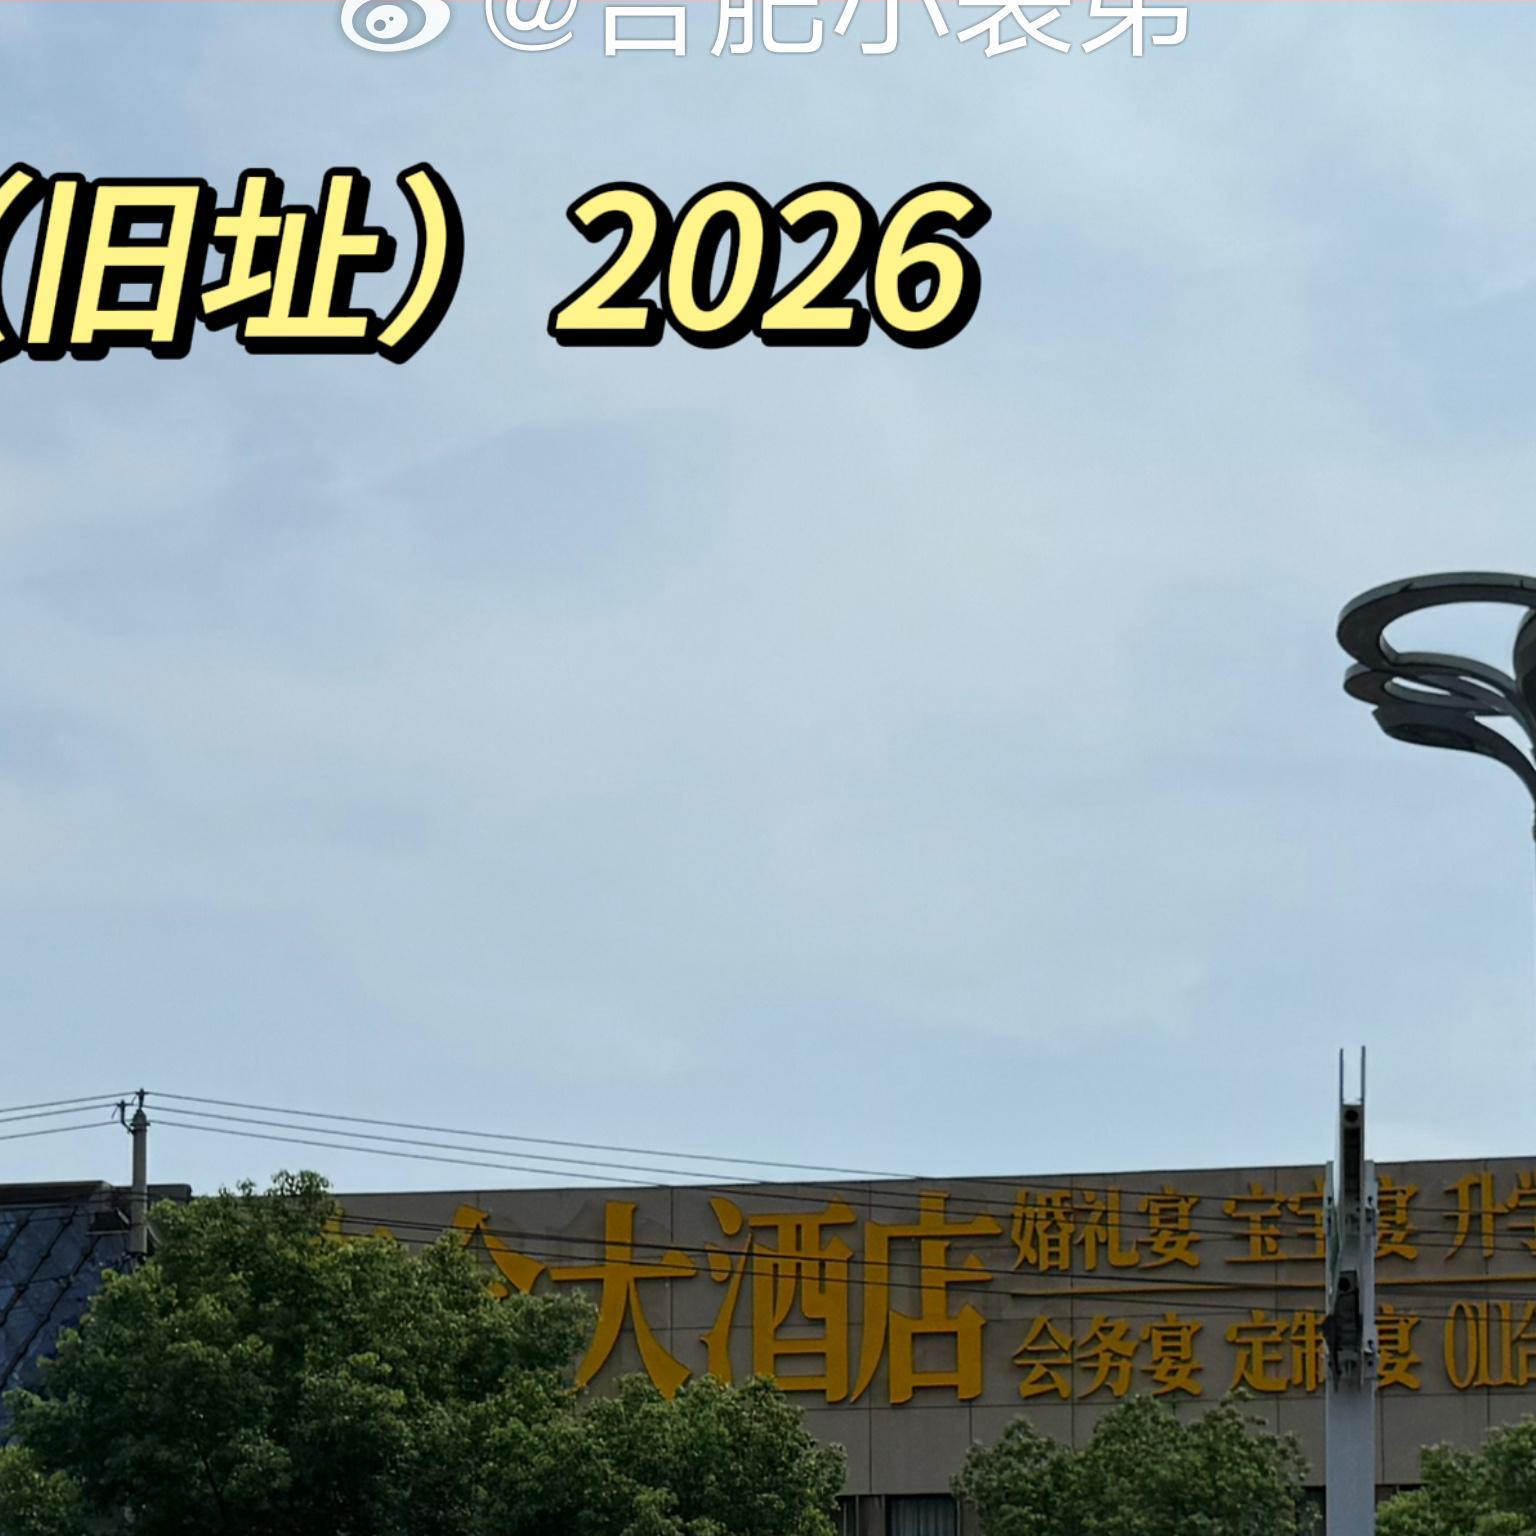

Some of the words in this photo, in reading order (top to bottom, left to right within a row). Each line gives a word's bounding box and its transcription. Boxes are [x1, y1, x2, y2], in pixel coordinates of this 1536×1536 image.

[1011, 1185, 1201, 1271] 婚礼宴
[452, 1191, 1004, 1405] 大酒店
[1013, 1312, 1204, 1399] 会务宴
[1224, 1303, 1424, 1393] 定制宴
